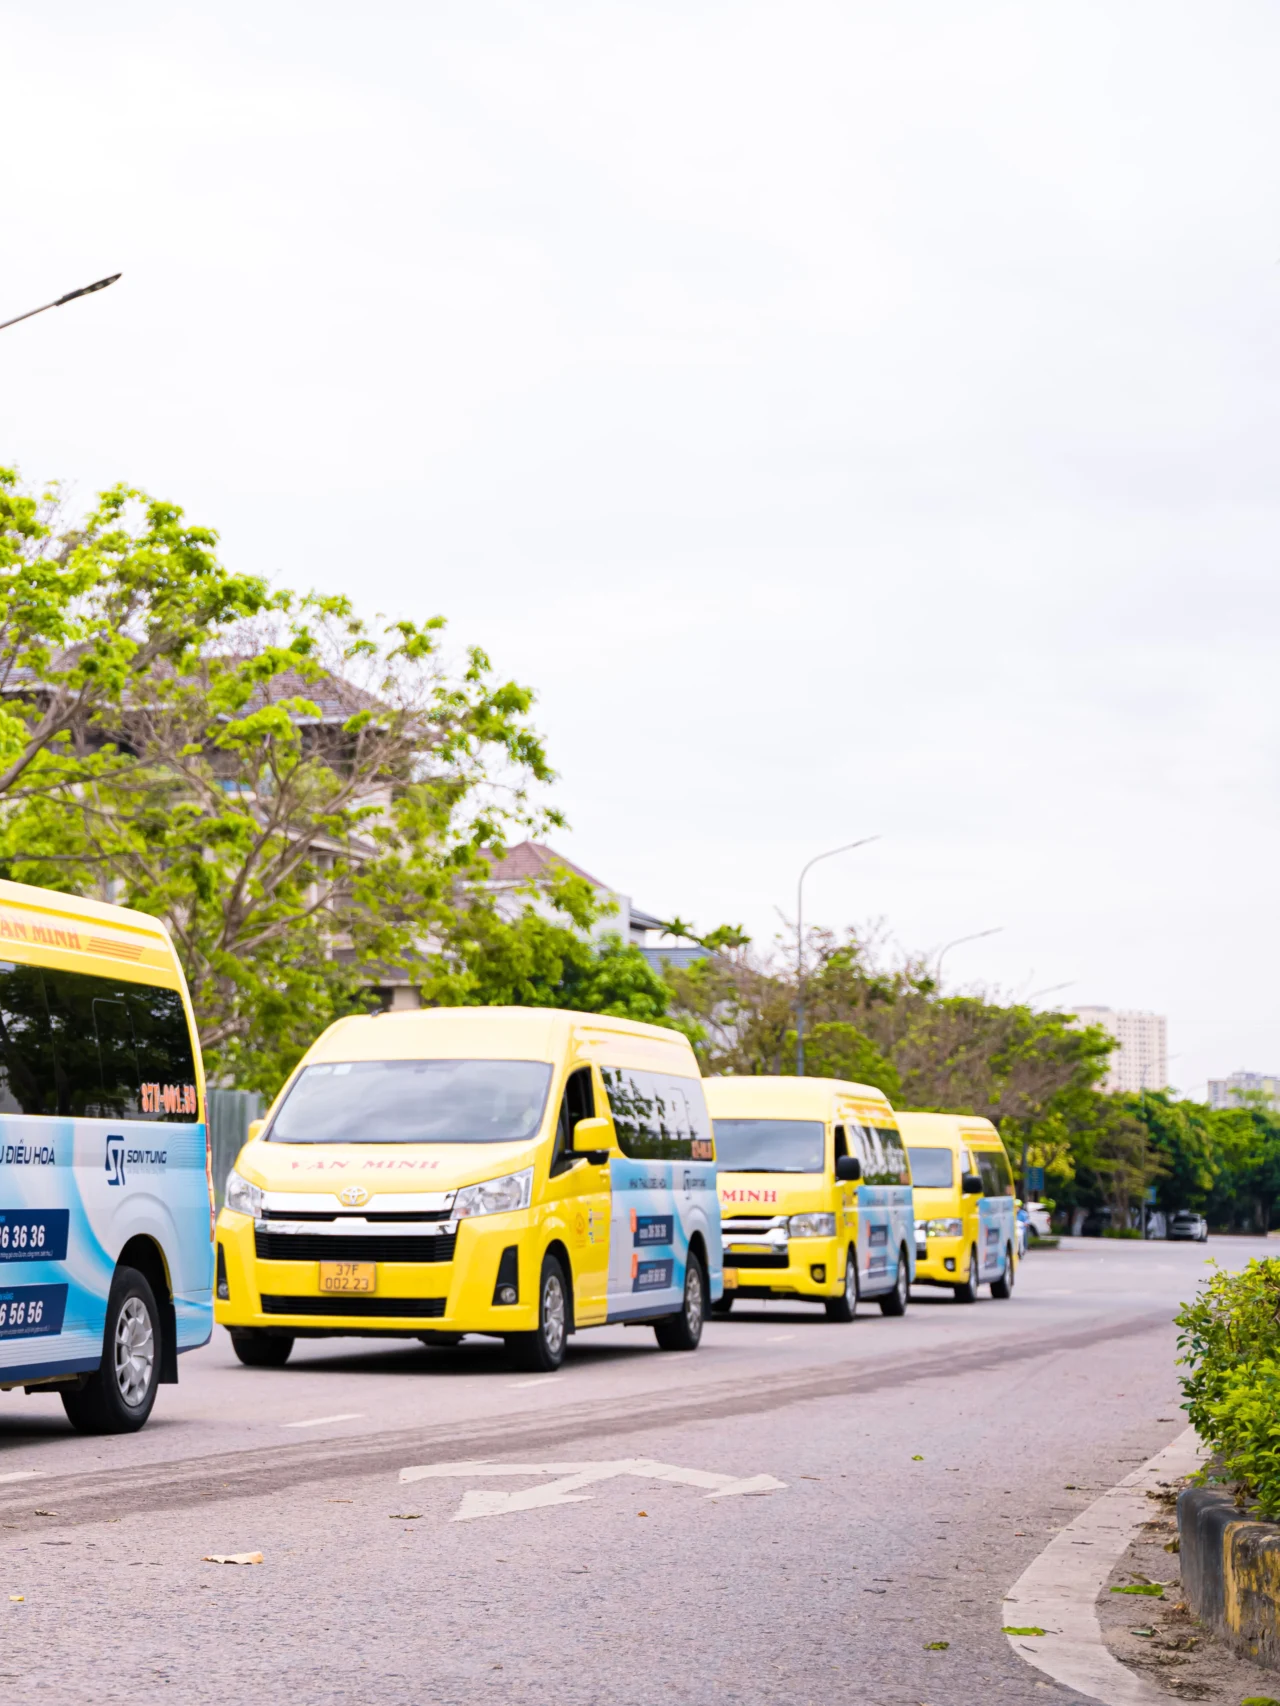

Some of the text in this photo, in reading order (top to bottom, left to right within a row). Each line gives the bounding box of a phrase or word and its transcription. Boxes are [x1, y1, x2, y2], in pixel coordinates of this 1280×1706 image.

[30, 920, 81, 950] MINH
[33, 1140, 56, 1166] HOÀ
[722, 1189, 777, 1203] MINH
[12, 1225, 28, 1248] 36
[29, 1225, 46, 1248] 36
[336, 1263, 359, 1276] 37F
[9, 1302, 25, 1325] 56
[27, 1301, 43, 1323] 56
